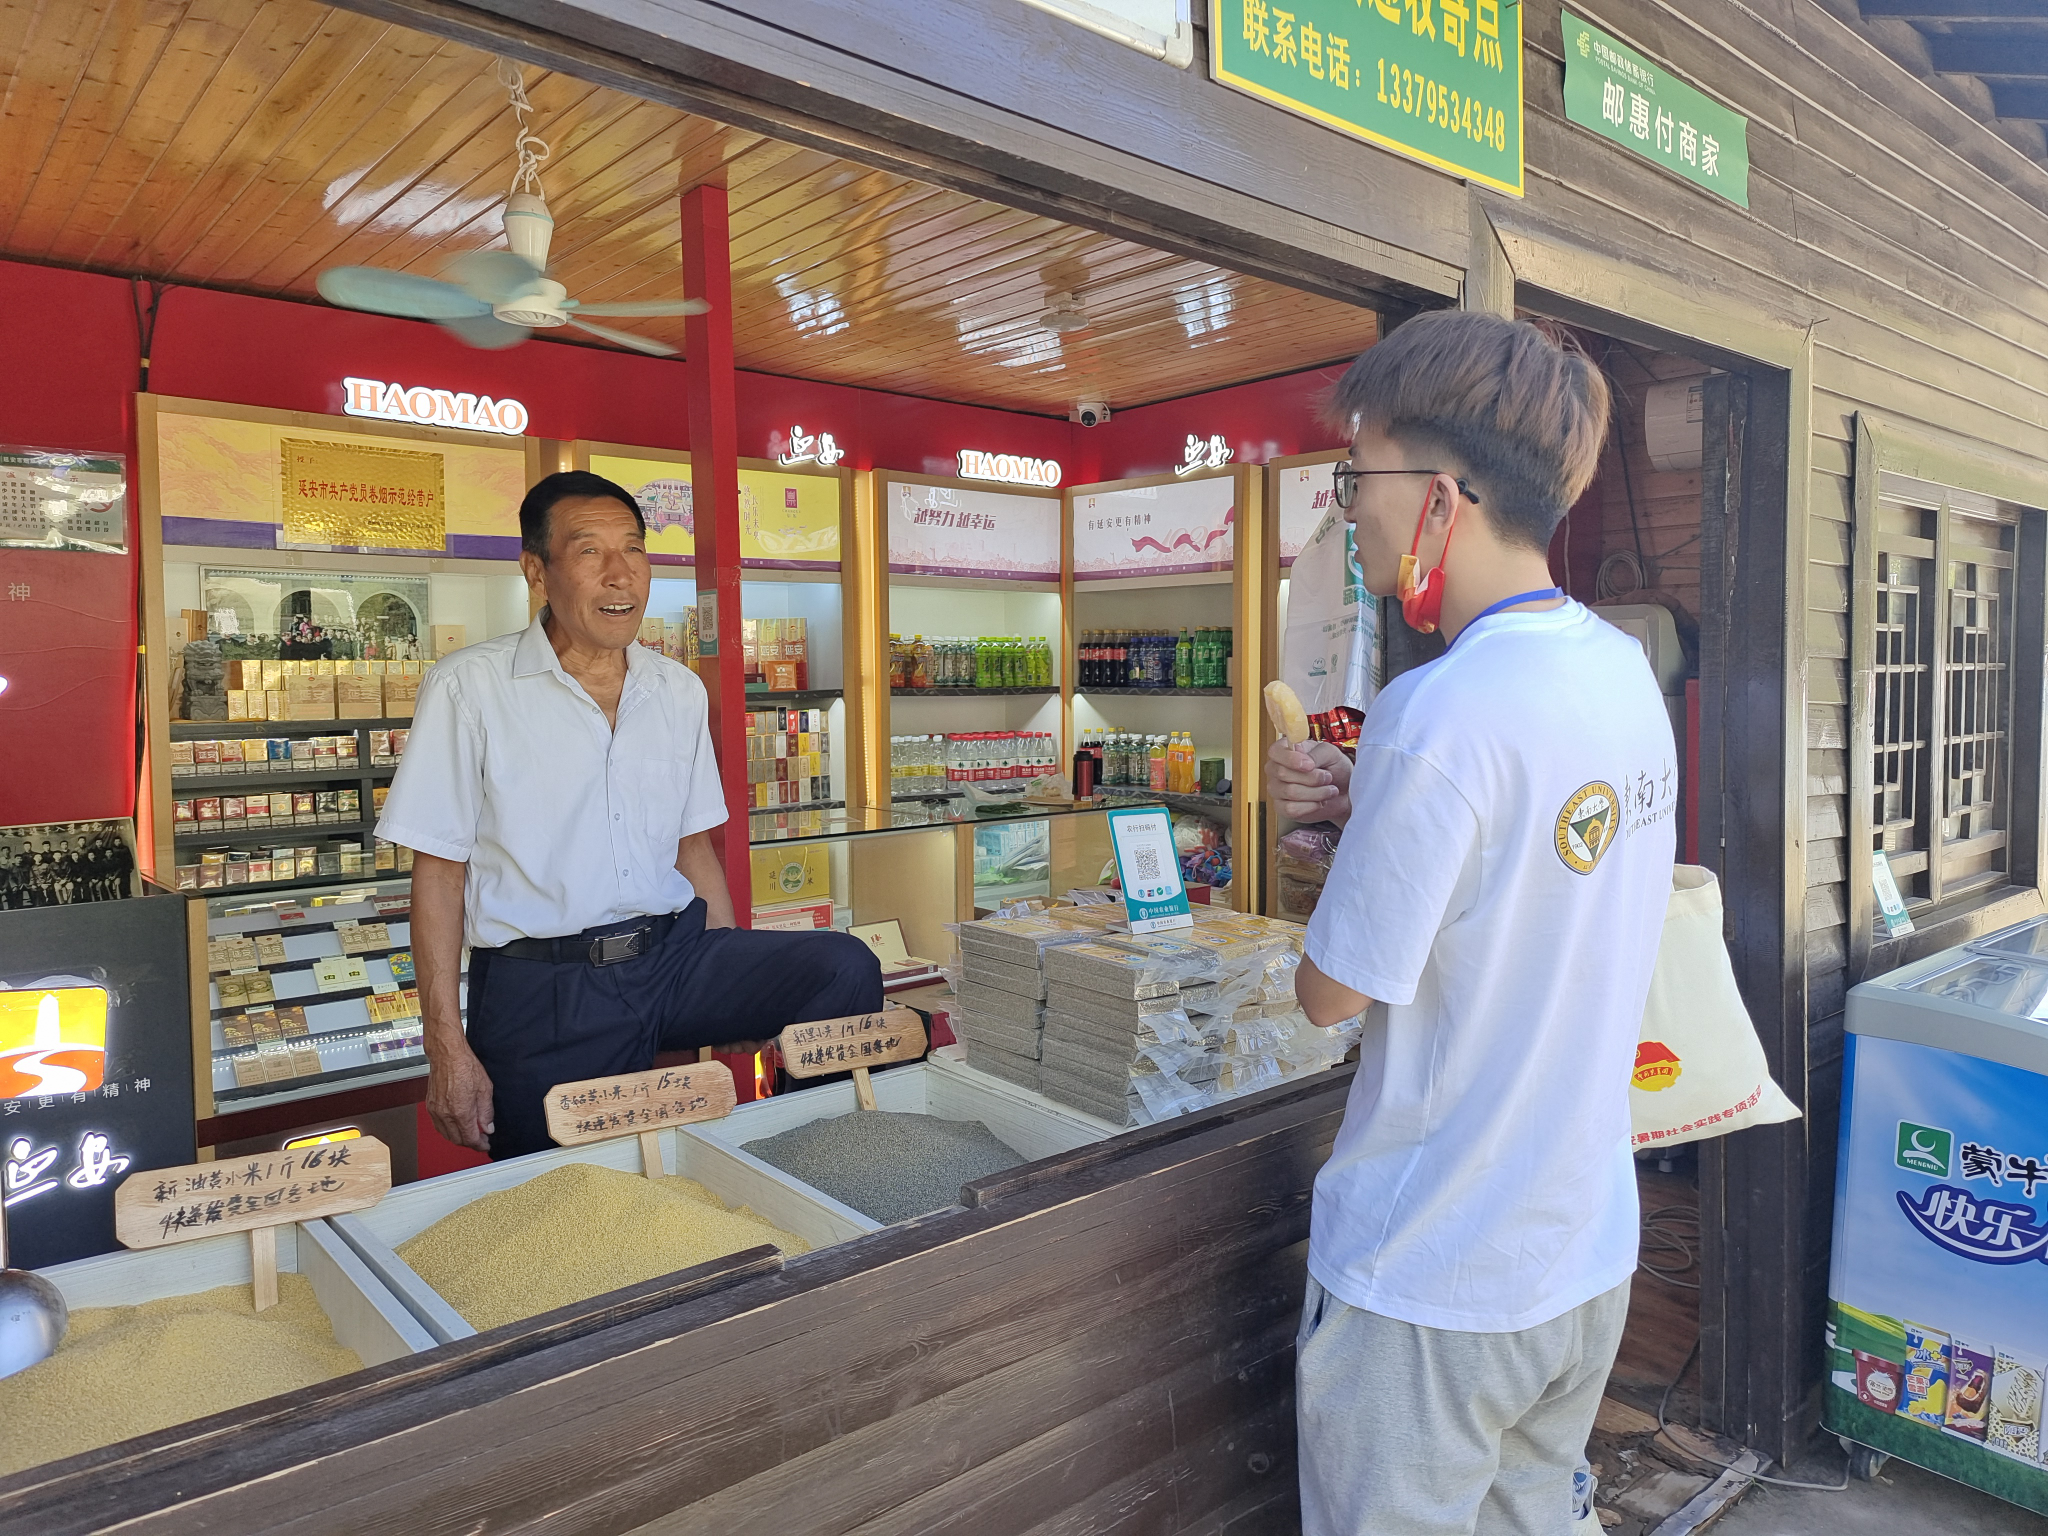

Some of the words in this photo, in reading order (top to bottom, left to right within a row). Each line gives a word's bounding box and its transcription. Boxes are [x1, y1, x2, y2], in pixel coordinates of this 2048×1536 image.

[1356, 0, 1505, 74] 收寄点
[1593, 40, 1655, 88] 中国邮政储蓄银行
[1602, 76, 1720, 177] 邮惠付商家
[346, 380, 525, 432] HAOMAO
[962, 453, 1060, 485] HAOMAO
[298, 479, 434, 508] 延安市共产党员卷烟示范经营户
[8, 582, 31, 602] 神
[785, 644, 804, 656] 延安
[1126, 823, 1158, 833] 农行扫码付
[1557, 790, 1589, 857] SOUTHEAST
[1591, 784, 1618, 832] UNIVERSITY
[806, 866, 815, 885] 小米
[1906, 1157, 1939, 1171] MENGNIU
[1961, 1143, 2048, 1197] 蒙牛
